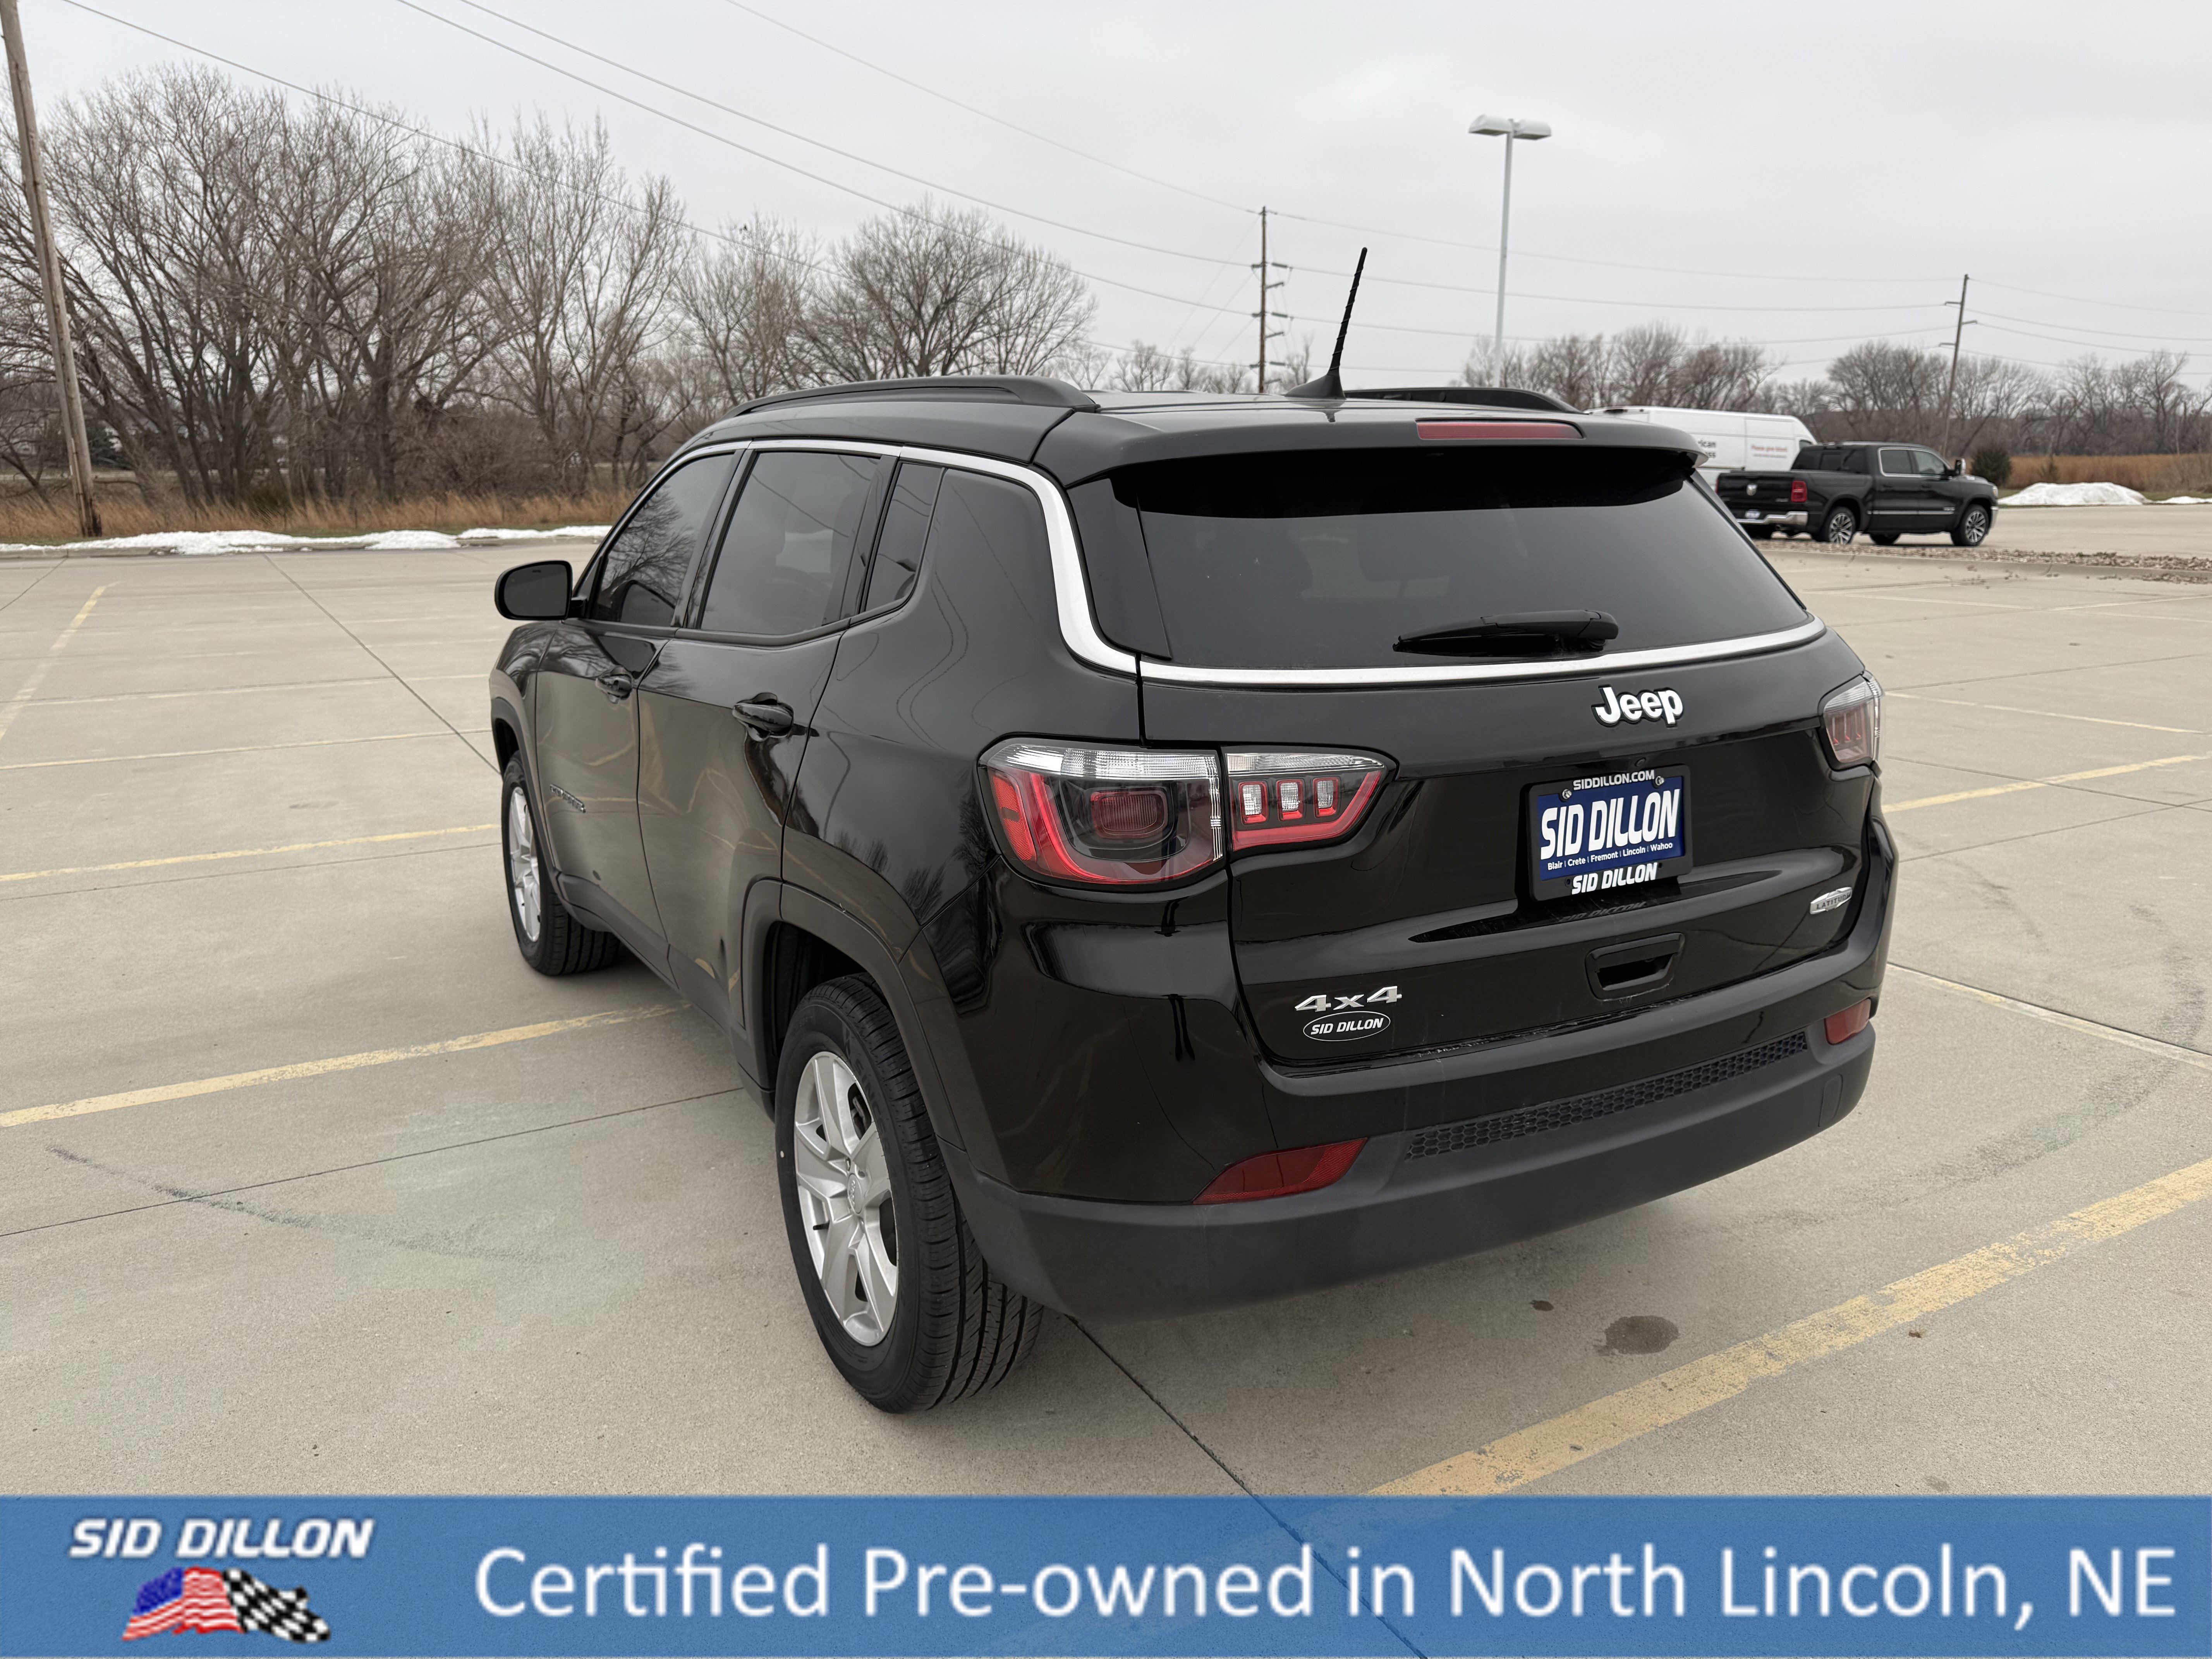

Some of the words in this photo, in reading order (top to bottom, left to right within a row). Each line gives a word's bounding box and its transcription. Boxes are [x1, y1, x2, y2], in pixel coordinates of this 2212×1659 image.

[1595, 687, 1683, 724] Jeep
[1573, 769, 1655, 790] SIDDILLON.COM
[1540, 804, 1584, 860] SID
[1588, 788, 1681, 852] DILLON
[1547, 861, 1563, 871] Blair
[1568, 857, 1586, 866] Crete
[1590, 851, 1618, 862] Fremont
[1623, 846, 1646, 857] Lincoln
[1650, 842, 1673, 852] Wahoo
[1571, 873, 1598, 895] SID
[1601, 862, 1658, 889] DILLON
[1310, 1023, 1334, 1035] SID
[1336, 1017, 1384, 1032] DILLON
